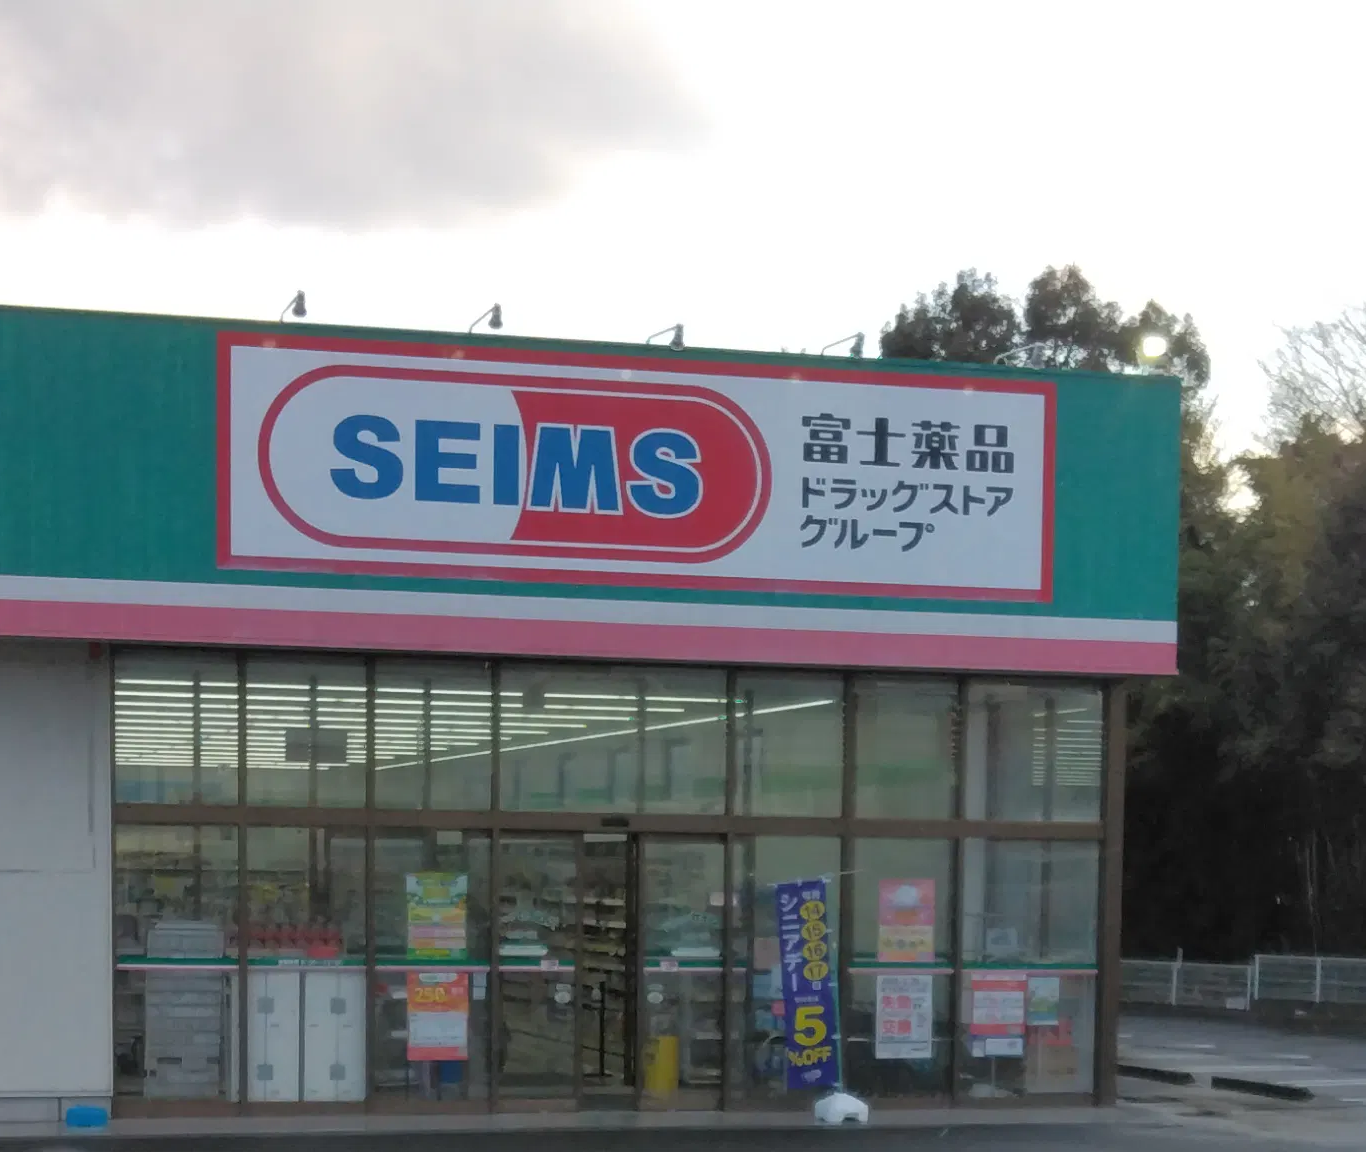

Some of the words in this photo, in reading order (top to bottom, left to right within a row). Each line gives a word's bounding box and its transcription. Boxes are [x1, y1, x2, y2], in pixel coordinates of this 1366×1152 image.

[800, 412, 1016, 475] 富士薬品
[329, 413, 702, 520] SEIMS
[799, 475, 1015, 517] ドラッグストア
[799, 514, 936, 553] グループ
[794, 1006, 827, 1046] 5
